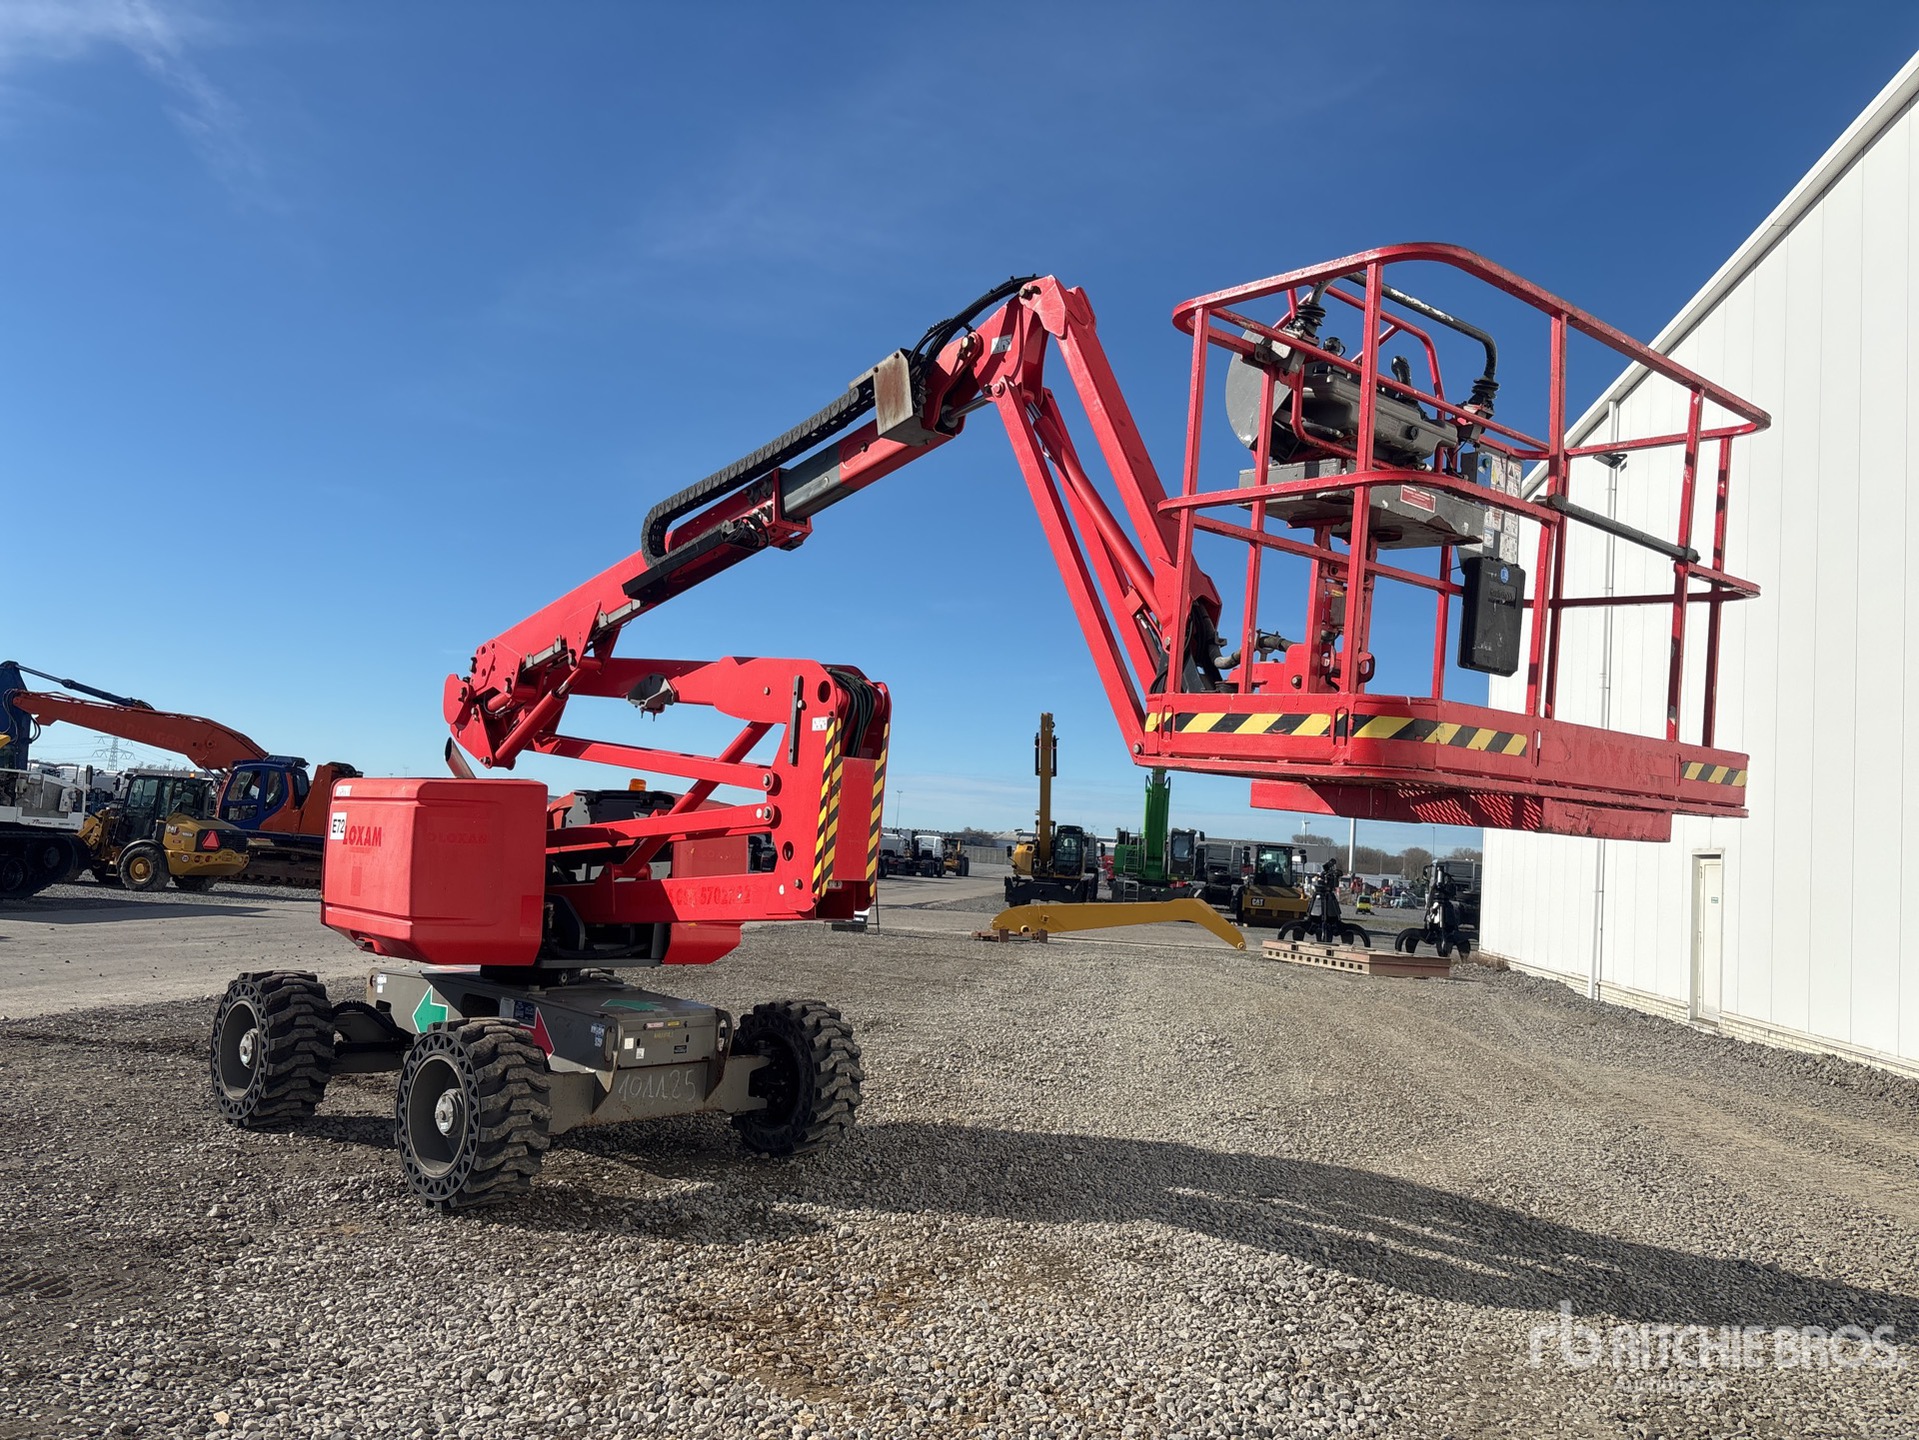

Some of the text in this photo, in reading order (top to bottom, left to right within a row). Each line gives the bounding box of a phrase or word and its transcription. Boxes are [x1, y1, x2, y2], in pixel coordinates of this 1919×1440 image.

[165, 823, 178, 834] CAT
[332, 818, 345, 834] E72
[342, 825, 383, 848] LOXAM
[1251, 898, 1264, 907] CAT
